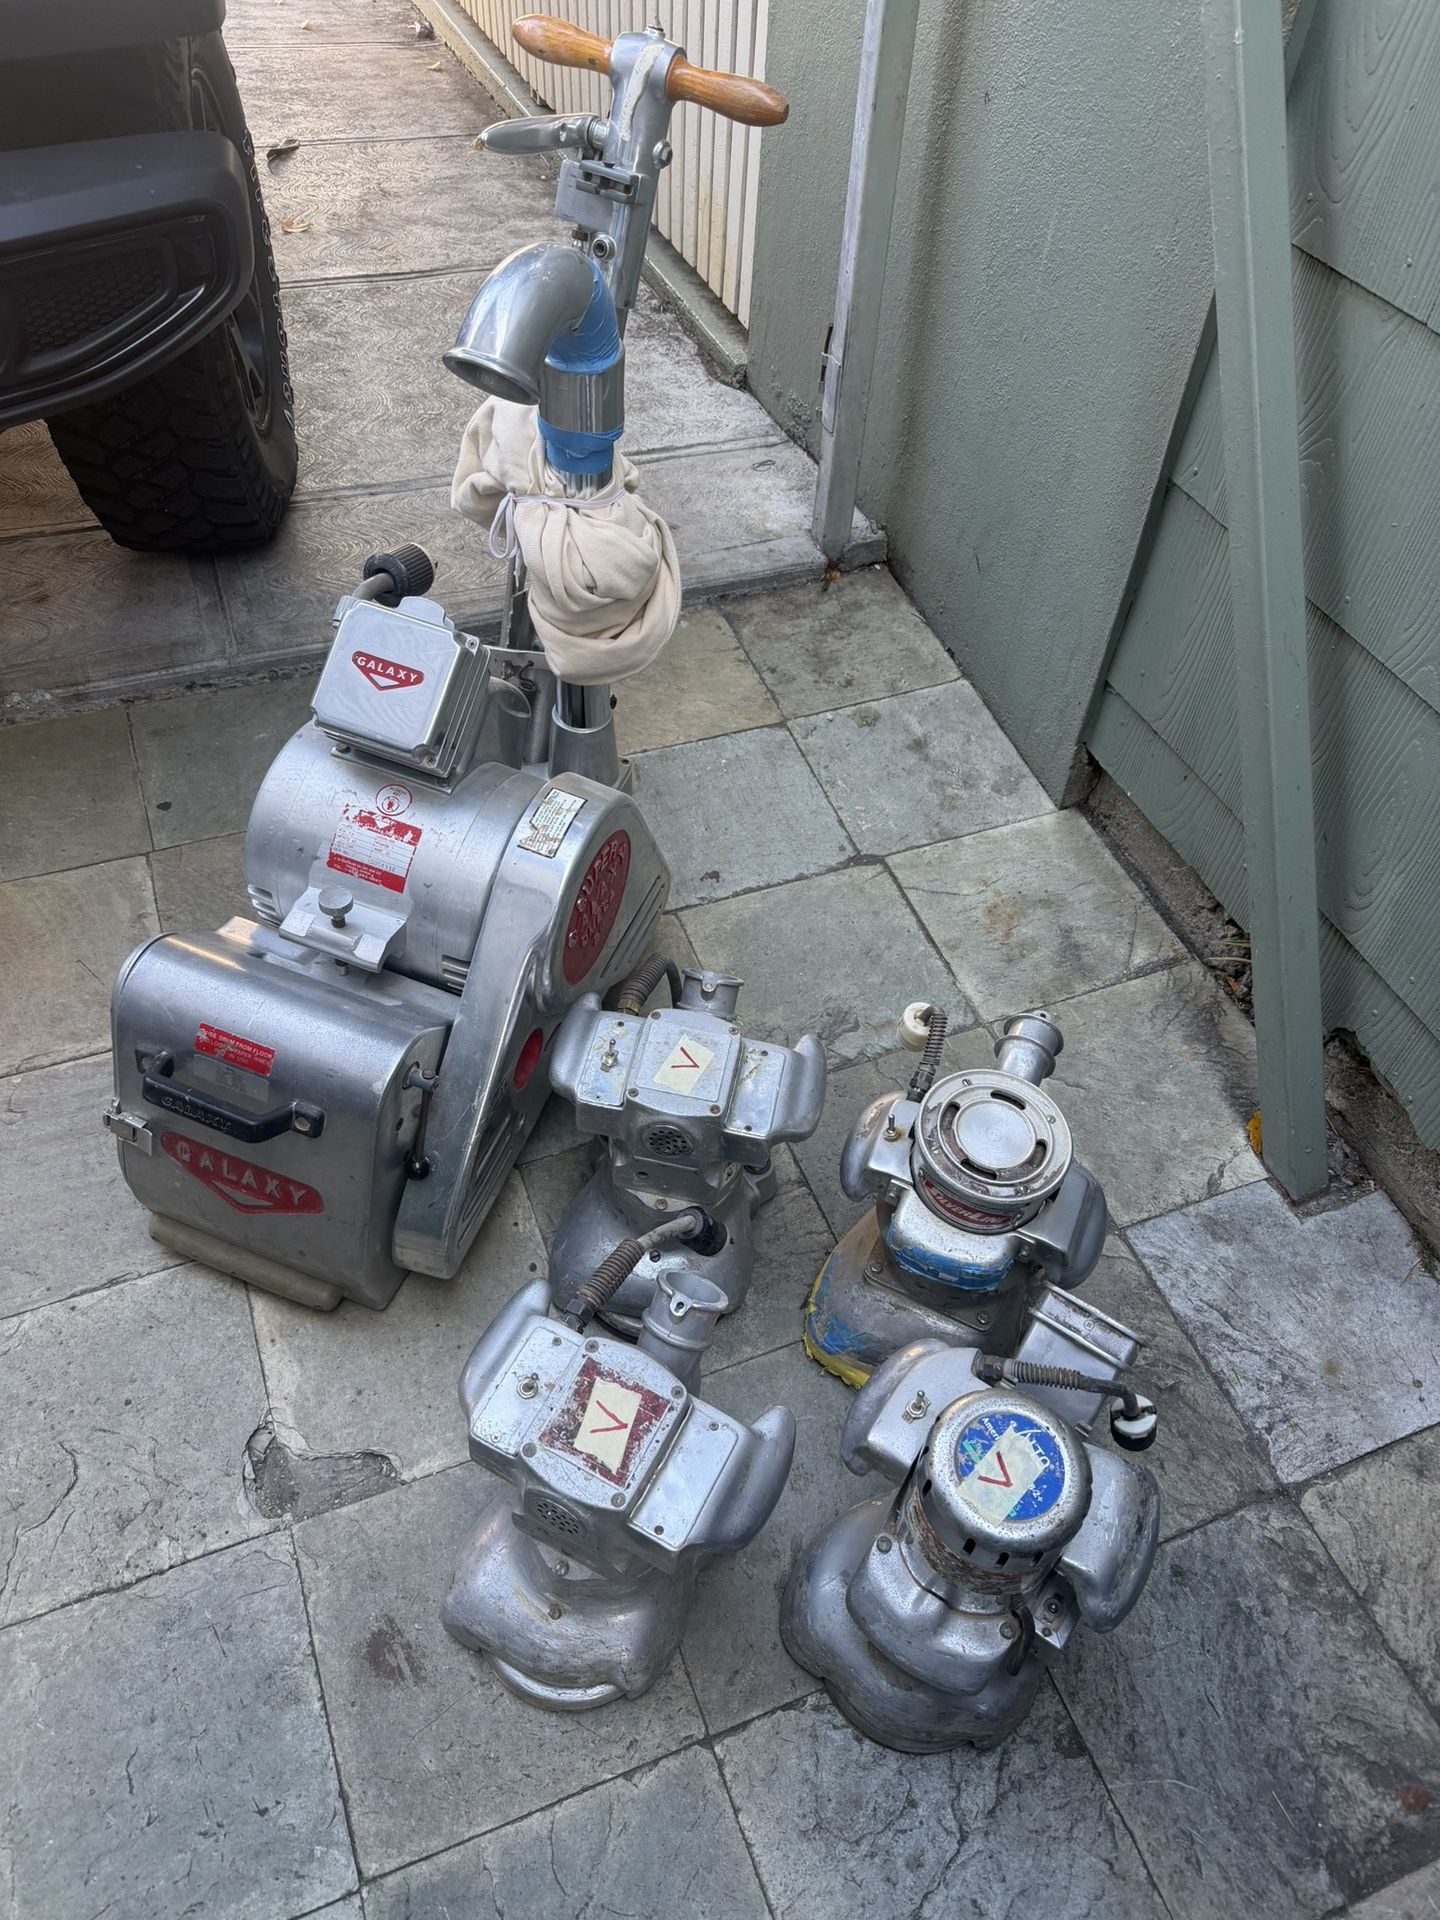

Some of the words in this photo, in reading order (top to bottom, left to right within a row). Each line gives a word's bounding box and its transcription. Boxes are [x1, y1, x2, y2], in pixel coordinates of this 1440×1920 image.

[356, 655, 418, 683] GALAXY
[235, 1040, 252, 1053] FROM
[252, 1046, 273, 1060] FLOOR
[160, 1095, 233, 1132] GALAXY
[175, 1141, 309, 1207] GALAXY
[982, 1416, 1001, 1441] Ameri
